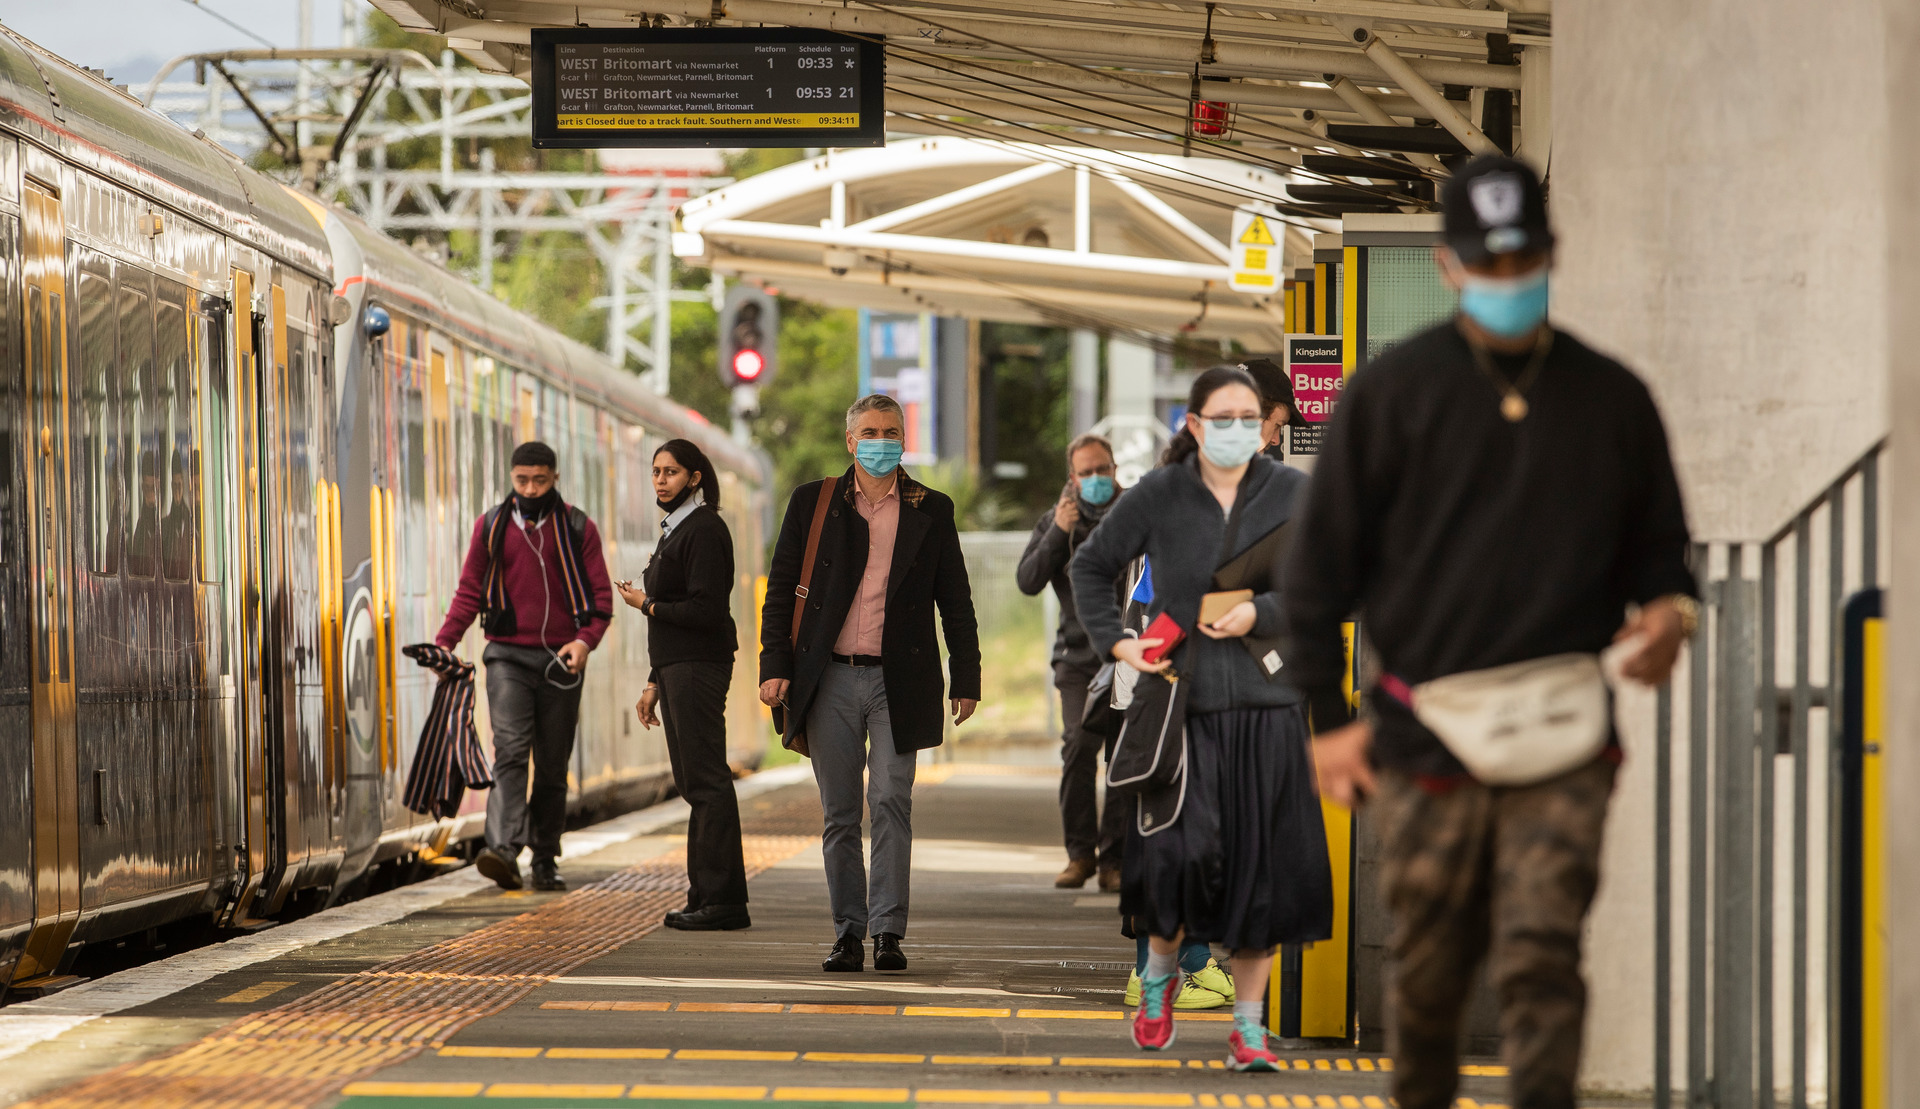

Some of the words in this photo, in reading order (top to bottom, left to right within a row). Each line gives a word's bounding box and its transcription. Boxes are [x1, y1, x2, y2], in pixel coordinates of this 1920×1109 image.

[561, 58, 598, 70] WEST
[604, 58, 672, 70] Britomart
[767, 58, 774, 68] 1
[797, 58, 833, 69] 09:33
[604, 74, 634, 82] Grafton,
[637, 74, 683, 82] Newmarket,
[685, 74, 714, 82] Parnell,
[561, 88, 598, 99] WEST
[604, 88, 672, 99] Britomart
[766, 88, 772, 98] 1
[796, 87, 832, 98] 09:53
[839, 87, 854, 98] 21
[604, 104, 635, 112] Grafton,
[686, 103, 714, 111] Parnell,
[586, 117, 615, 126] Closed
[1295, 348, 1337, 357] Kingsland
